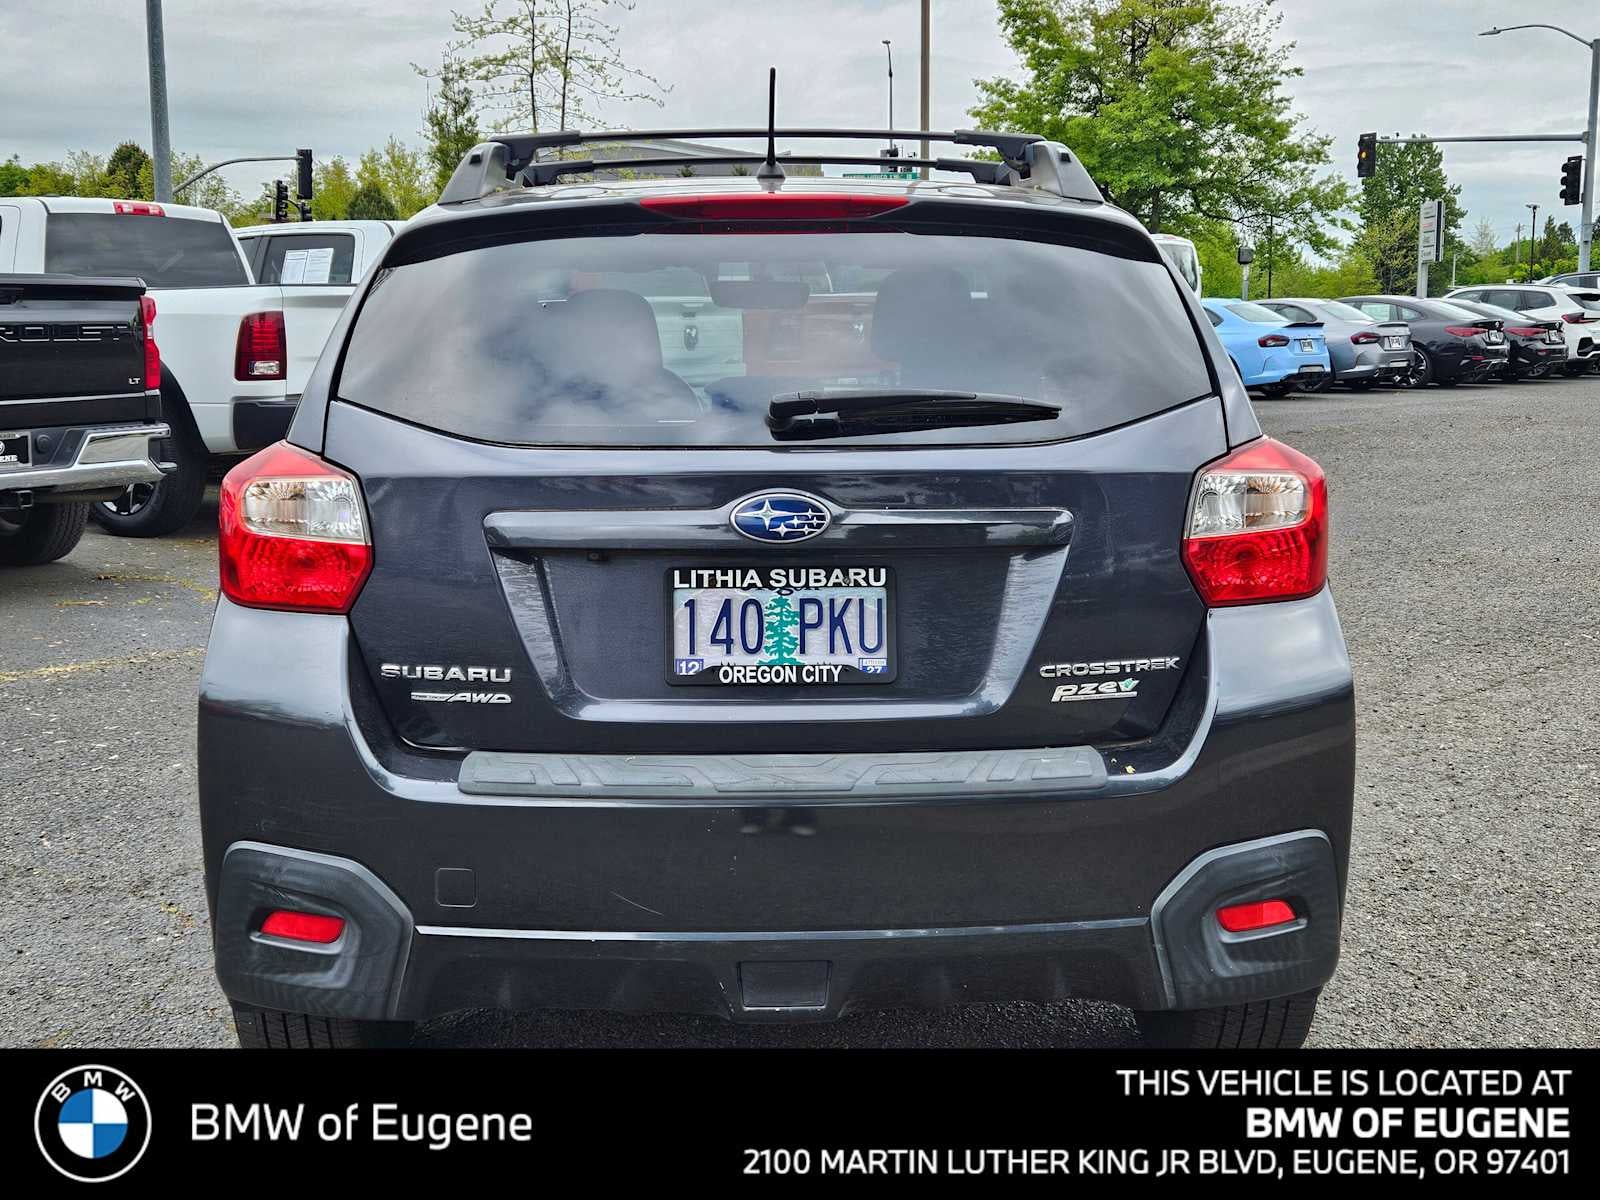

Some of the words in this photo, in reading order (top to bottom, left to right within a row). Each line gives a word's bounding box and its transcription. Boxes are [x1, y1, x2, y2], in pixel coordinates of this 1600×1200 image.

[129, 377, 141, 385] LT
[674, 569, 762, 589] LITHIA
[769, 567, 886, 588] SUBARU
[684, 598, 764, 656] 140
[799, 597, 883, 656] PKU
[380, 662, 512, 683] SUBARU
[680, 660, 700, 676] 12
[719, 666, 797, 684] OREGON
[802, 665, 842, 683] CITY
[1039, 656, 1181, 678] CROSSTREK
[447, 692, 512, 704] AWD
